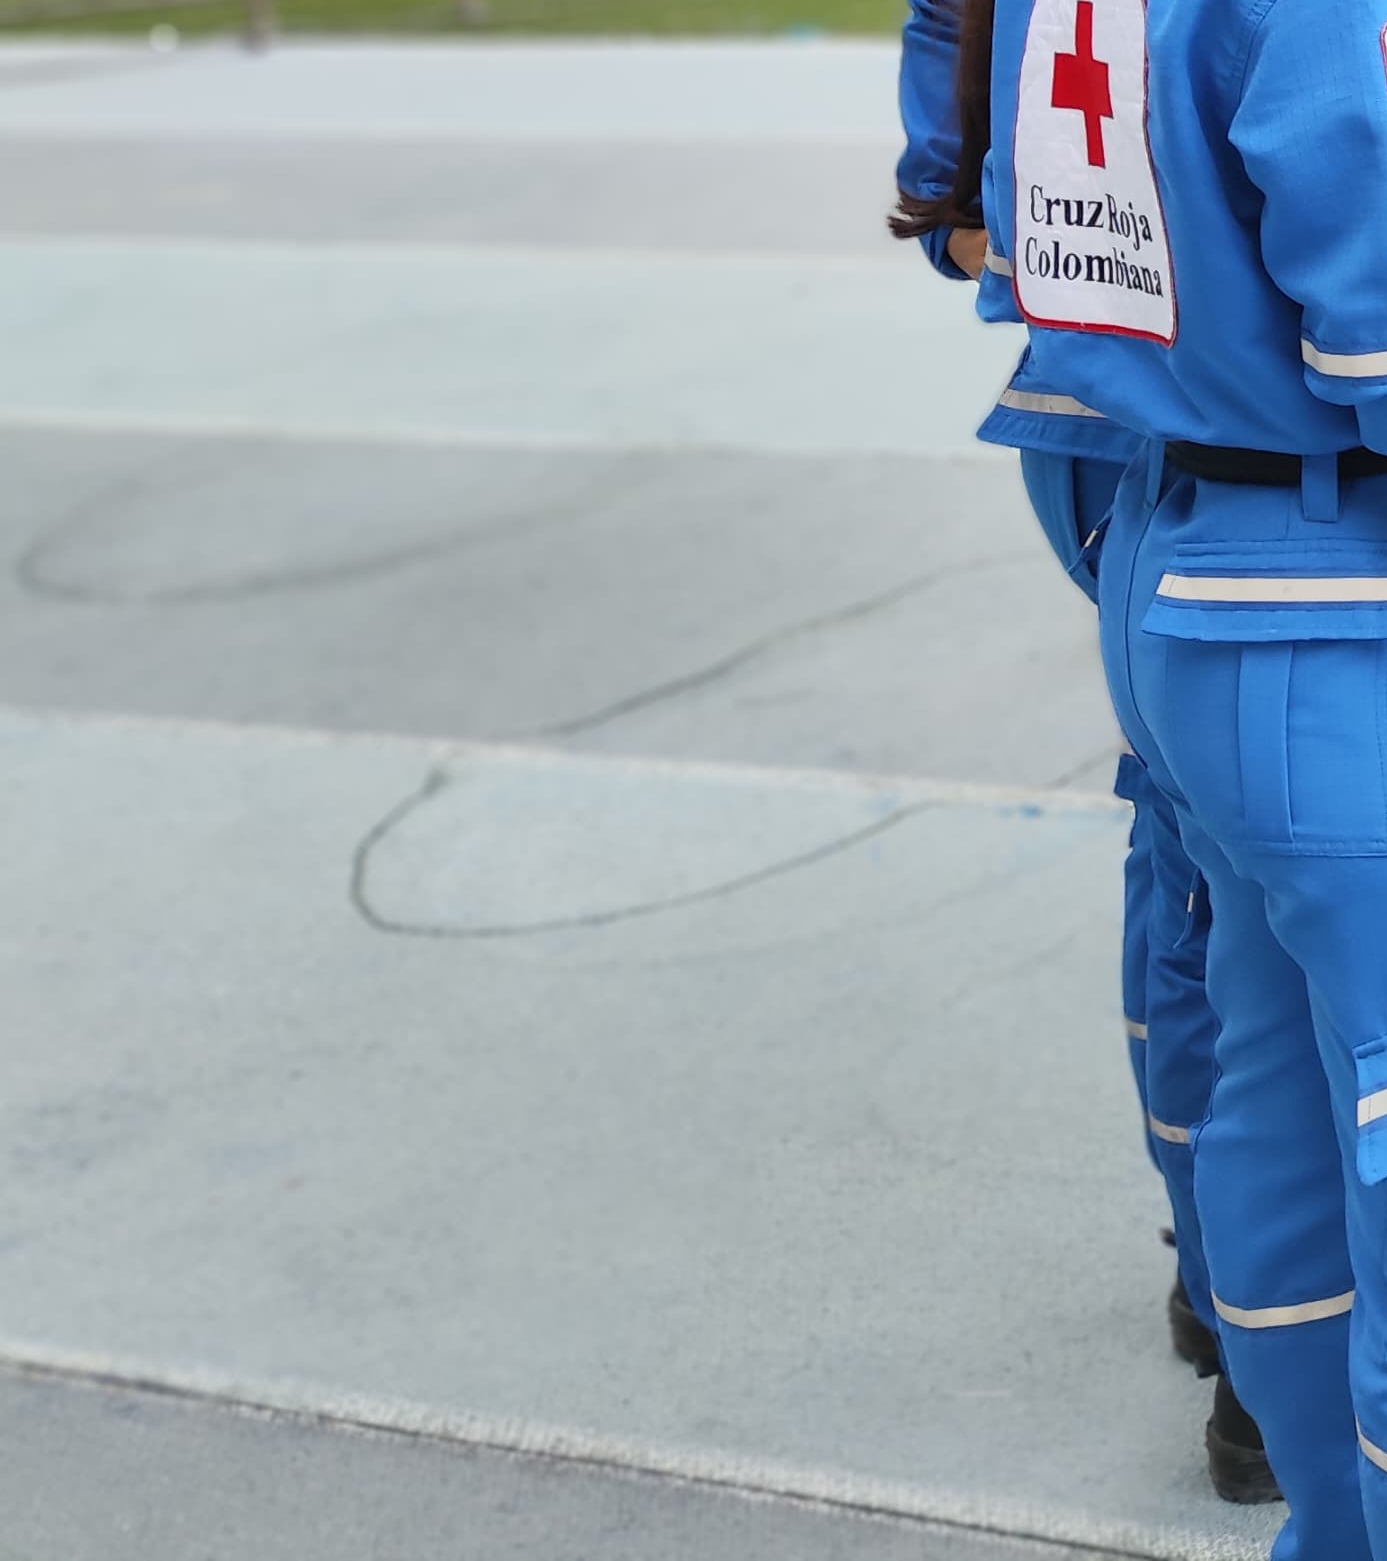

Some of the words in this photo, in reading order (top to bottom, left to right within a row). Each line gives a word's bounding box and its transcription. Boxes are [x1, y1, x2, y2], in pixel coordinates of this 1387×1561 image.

[1030, 185, 1105, 229] Cruz
[1106, 193, 1153, 250] Roja
[1025, 237, 1164, 299] Colombiana
